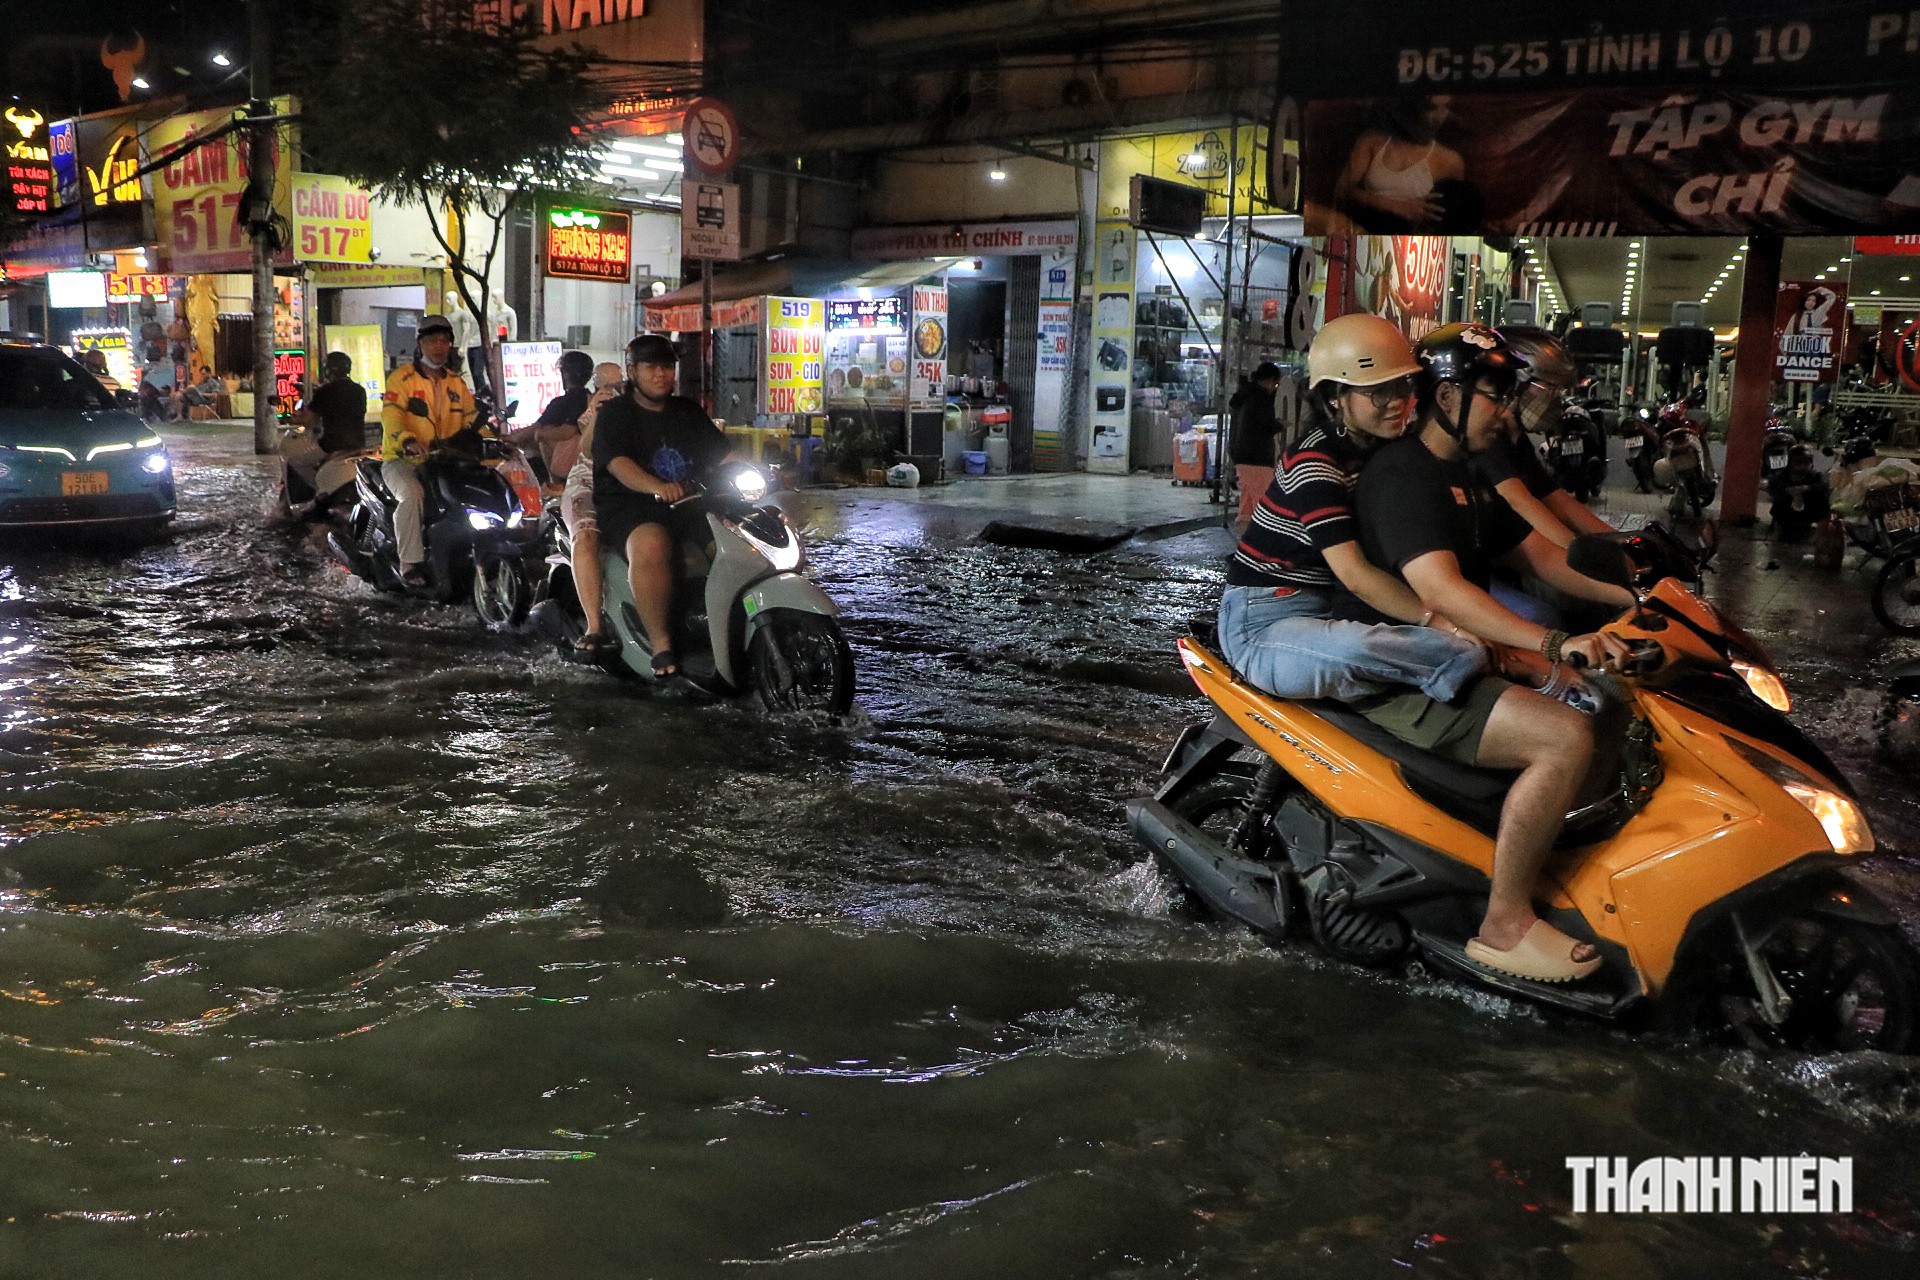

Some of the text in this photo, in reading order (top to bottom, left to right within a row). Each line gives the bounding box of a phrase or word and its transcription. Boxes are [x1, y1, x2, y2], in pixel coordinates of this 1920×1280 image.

[1561, 22, 1661, 75] TỈNH
[1676, 17, 1733, 77] LỘ
[1753, 22, 1811, 64] 10
[1607, 93, 1890, 162] TẬP GYM
[25, 167, 50, 180] XÁCH
[1674, 155, 1796, 217] CHỈ
[296, 181, 369, 221] CẦM ĐỒ
[172, 193, 244, 251] 517
[301, 224, 366, 256] 517 BT
[602, 232, 627, 262] NAM
[973, 228, 1022, 247] CHÍNH
[600, 262, 611, 275] LỘ
[613, 265, 622, 275] 10
[1405, 236, 1445, 297] 50%
[109, 275, 164, 295] 513
[782, 302, 810, 316] 519
[914, 286, 930, 312] BÚN
[770, 322, 797, 354] BÚN
[1781, 334, 1832, 353] TIKTOK
[770, 362, 792, 385] SỤN
[803, 358, 820, 380] GIÒ
[917, 362, 942, 382] 35K
[1776, 355, 1833, 368] DANCE
[769, 387, 796, 413] 30K
